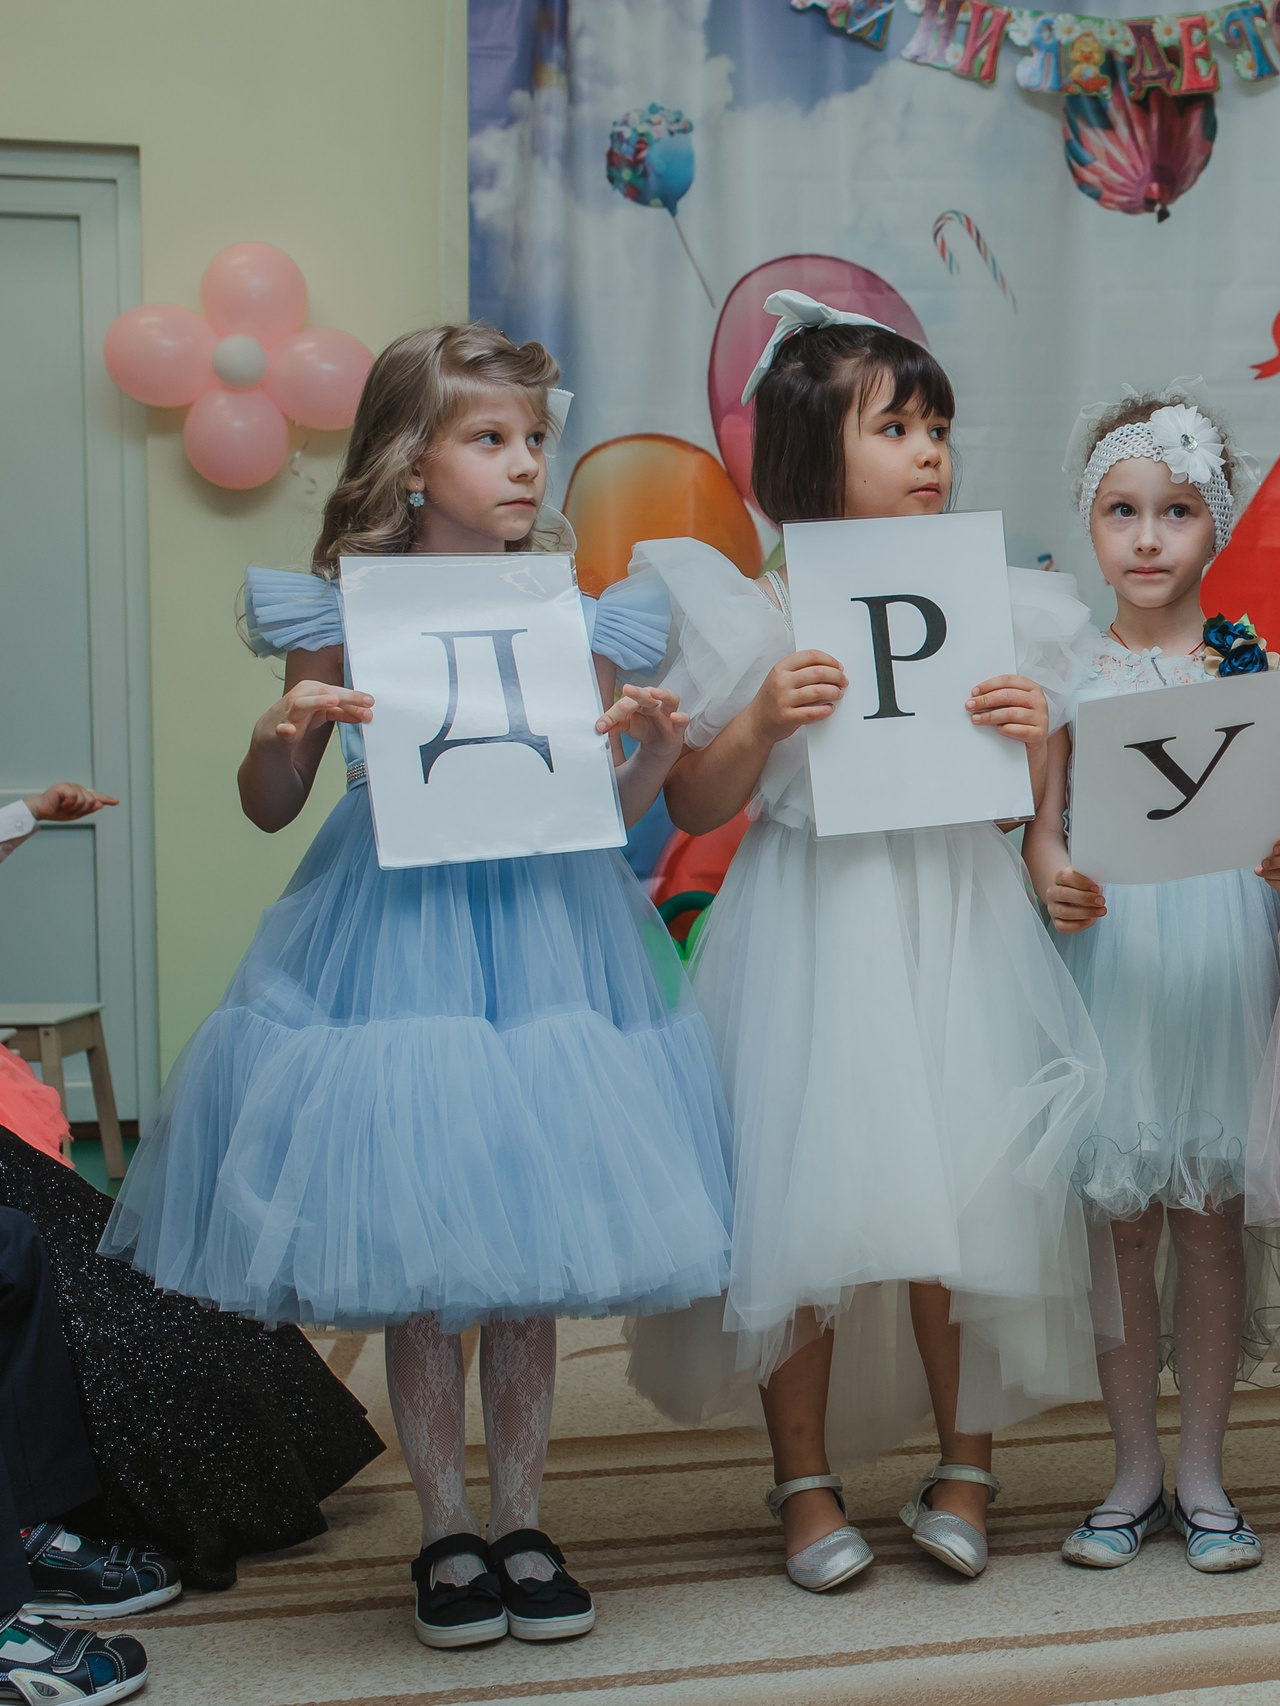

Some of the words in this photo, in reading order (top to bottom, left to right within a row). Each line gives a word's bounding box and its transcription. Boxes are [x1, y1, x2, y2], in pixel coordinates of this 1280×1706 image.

[418, 628, 555, 785] Д
[850, 594, 947, 720] Р
[1123, 721, 1256, 821] У
